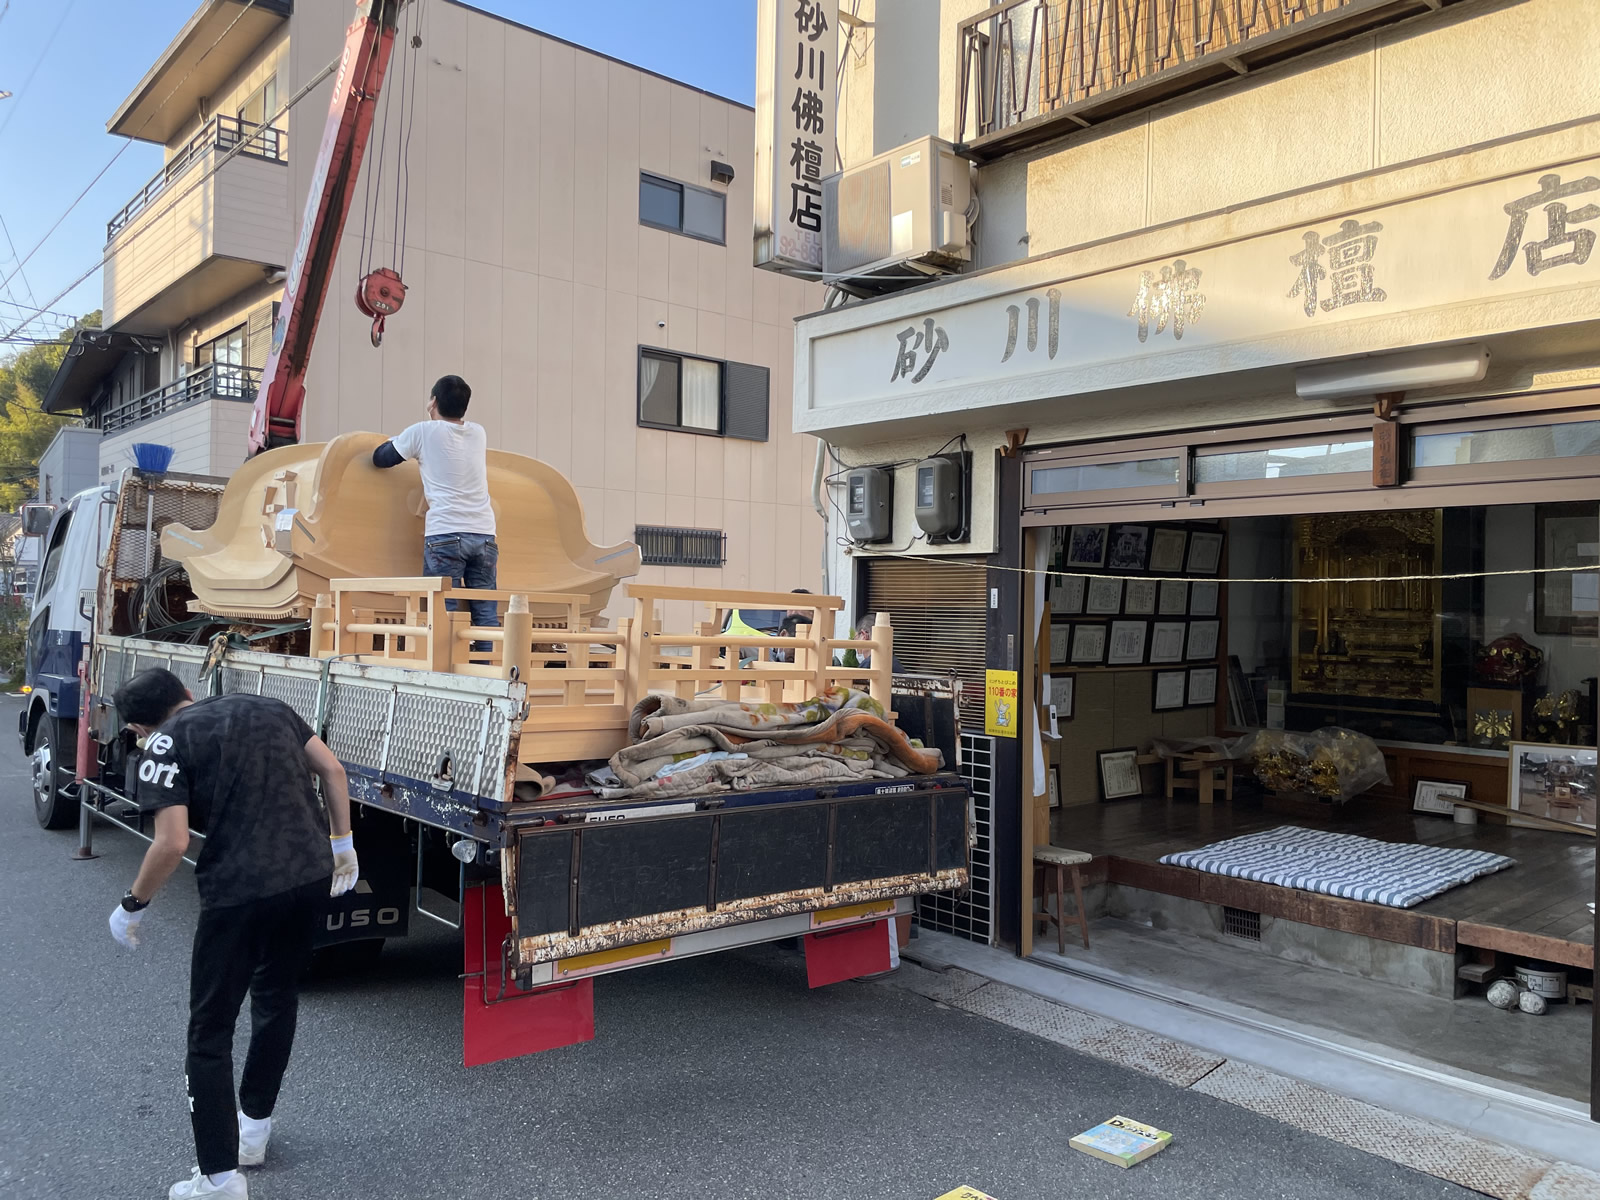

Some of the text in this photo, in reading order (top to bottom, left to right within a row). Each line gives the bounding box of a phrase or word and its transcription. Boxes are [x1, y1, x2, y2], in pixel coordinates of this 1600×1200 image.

[789, 0, 829, 234] 砂川佛檀店
[794, 229, 821, 246] TEL
[890, 173, 1600, 385] 砂川佛檀店
[988, 686, 1017, 698] 110番の家
[139, 759, 180, 789] ort
[326, 907, 400, 931] USO
